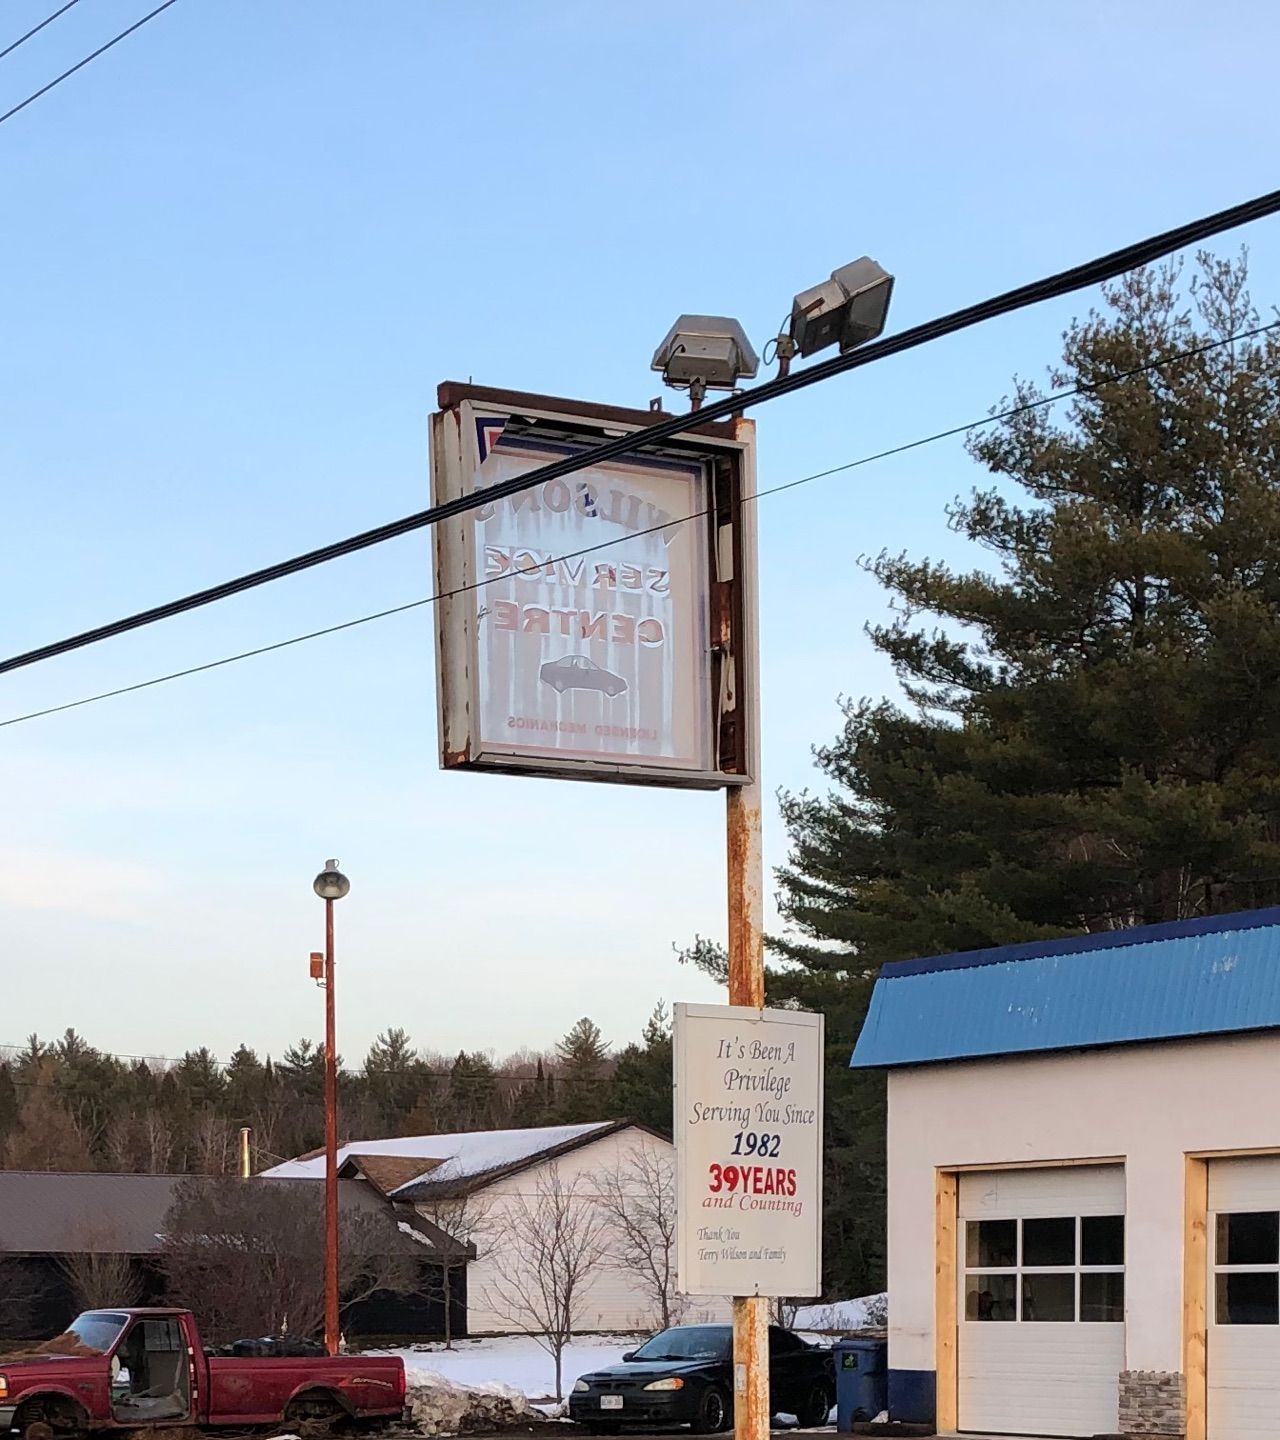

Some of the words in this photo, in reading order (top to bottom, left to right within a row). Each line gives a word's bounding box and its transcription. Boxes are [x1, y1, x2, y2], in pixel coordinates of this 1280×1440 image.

[717, 1036, 745, 1059] It's
[749, 1039, 782, 1061] Been
[783, 1042, 796, 1064] A
[724, 1067, 791, 1100] Privilege
[689, 1101, 751, 1129] Serving
[754, 1101, 780, 1123] You
[782, 1104, 815, 1126] Since
[731, 1131, 781, 1158] 1982
[702, 1193, 738, 1209] and
[740, 1195, 803, 1217] Counting
[697, 1226, 725, 1243] Thank
[726, 1227, 740, 1241] You
[698, 1247, 719, 1264] Terry
[721, 1246, 747, 1261] Wilson
[749, 1247, 761, 1260] and
